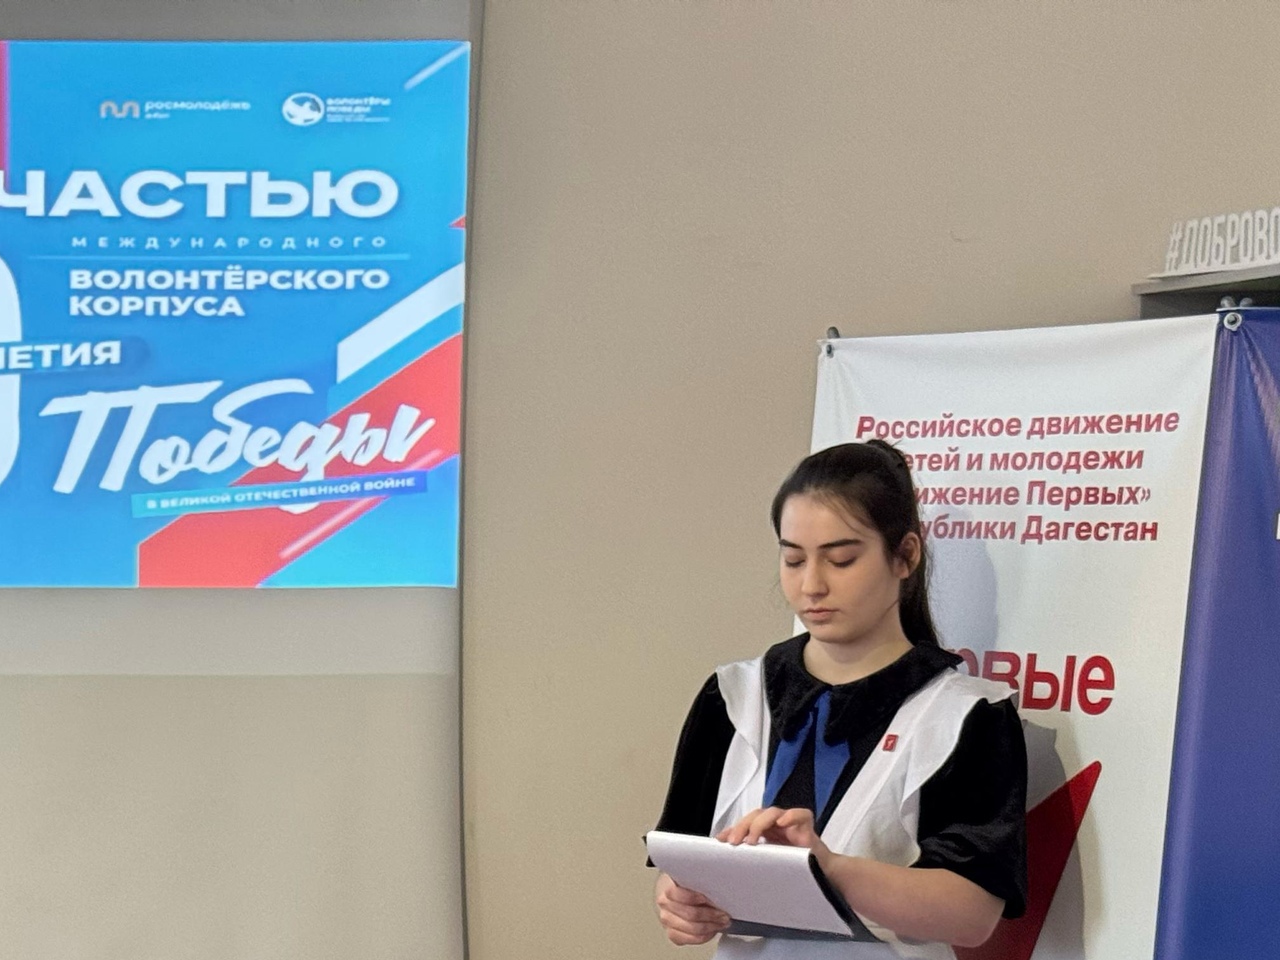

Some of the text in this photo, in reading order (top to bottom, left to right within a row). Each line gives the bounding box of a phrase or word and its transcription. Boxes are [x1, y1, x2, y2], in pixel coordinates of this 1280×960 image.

[71, 236, 388, 250] МЕЖДУНАРОДНОГО
[70, 264, 391, 291] ВОЛОНТЁРСКОГО
[70, 295, 246, 317] КОРПУСА
[855, 412, 1181, 440] Российское движение
[38, 378, 436, 514] Победы
[904, 446, 1145, 475] етей и молодежи
[146, 476, 416, 509] В ВЕЛИКОЙ ОТЕЧЕСТВЕННОЙ ВОЙНЕ
[917, 480, 1151, 511] ижение Первых»
[920, 513, 1159, 545] ублики Дагестан
